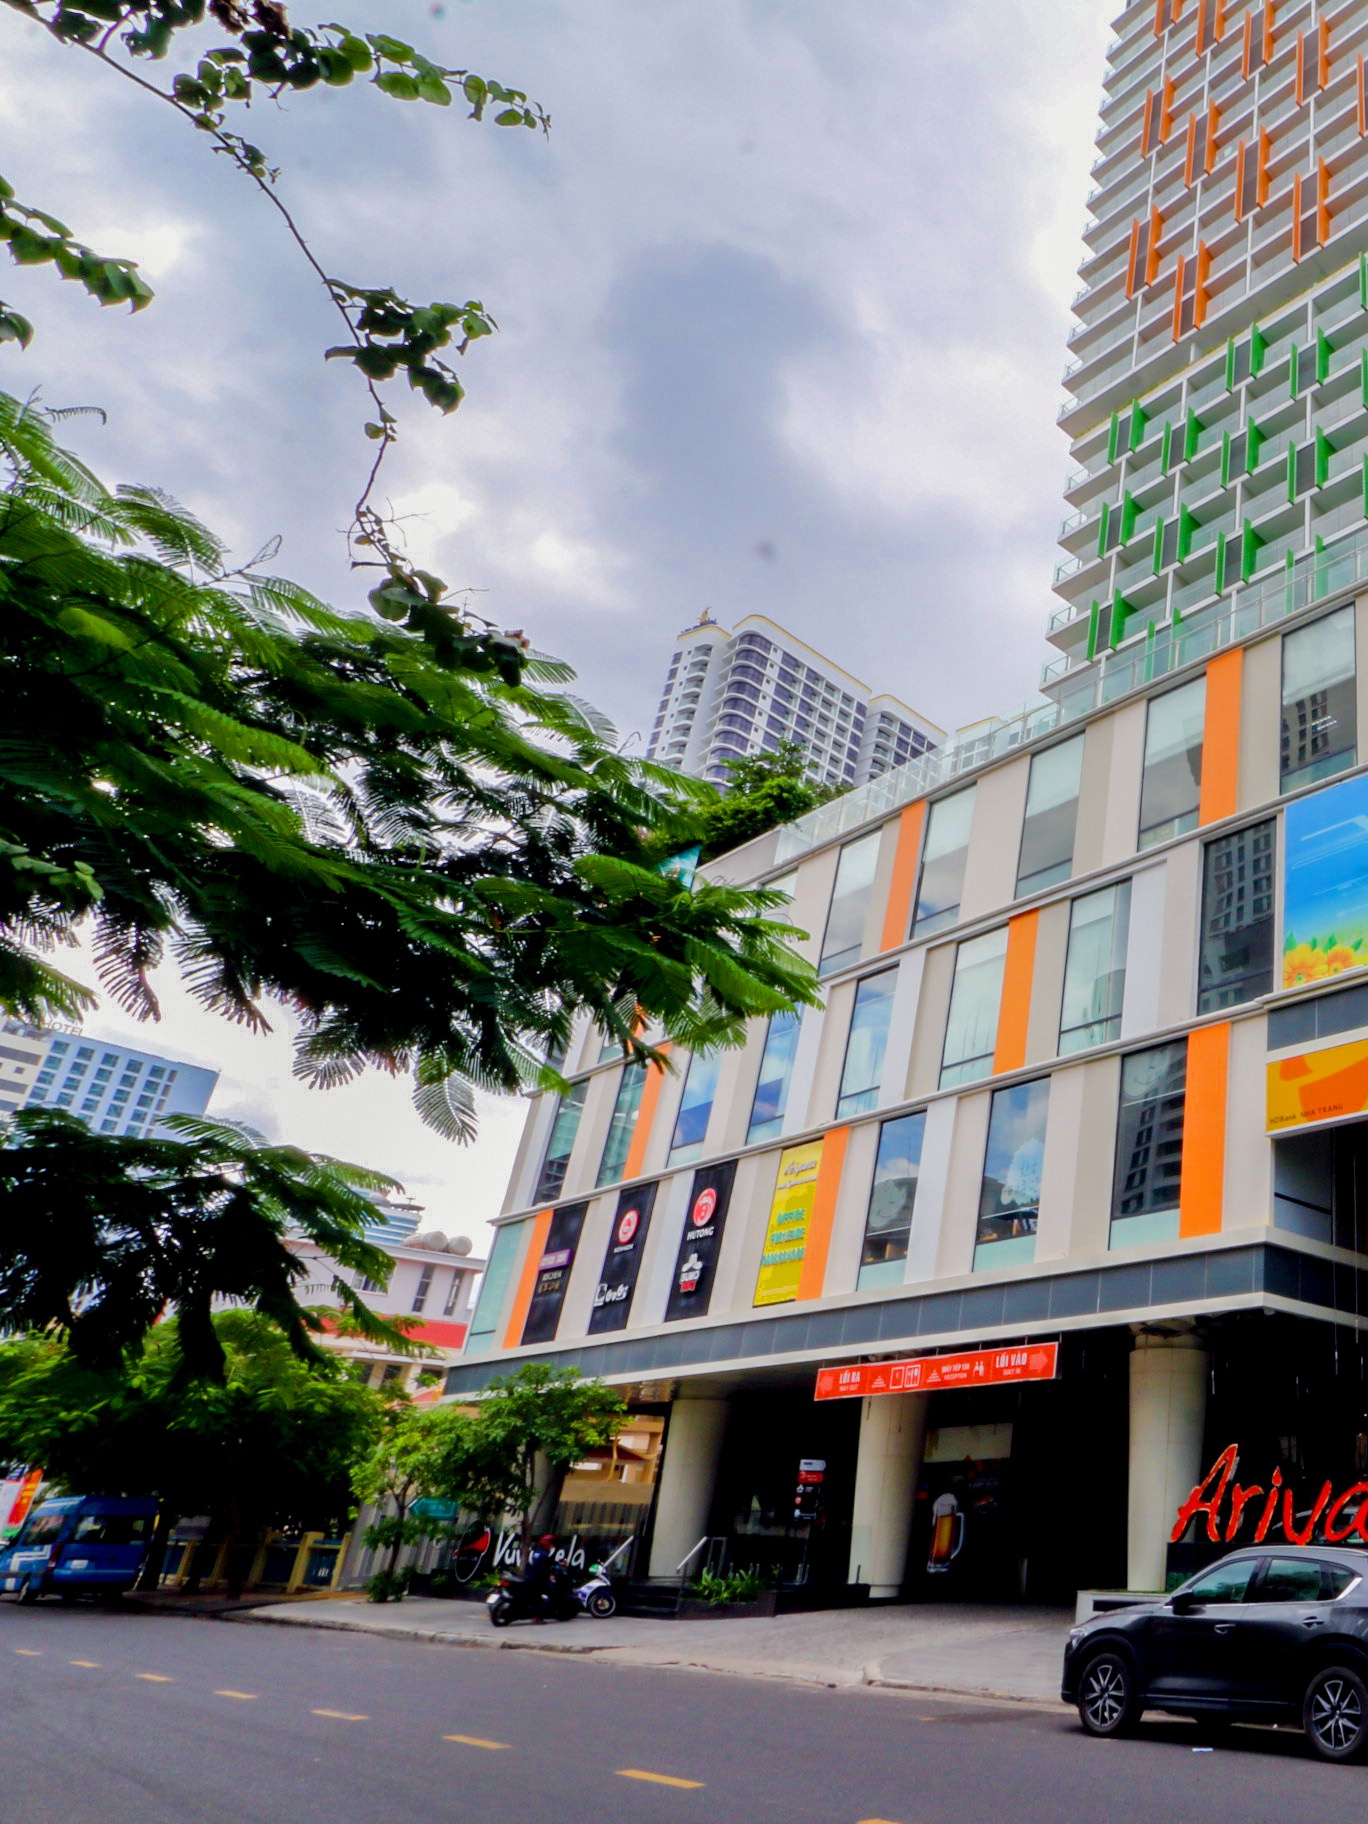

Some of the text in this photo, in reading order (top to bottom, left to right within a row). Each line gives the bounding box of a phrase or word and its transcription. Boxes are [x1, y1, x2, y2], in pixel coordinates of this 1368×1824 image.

[1270, 1103, 1343, 1124] HDBank NHA TRANG
[687, 1226, 714, 1240] HUTONG
[996, 1352, 1009, 1368] LỐI
